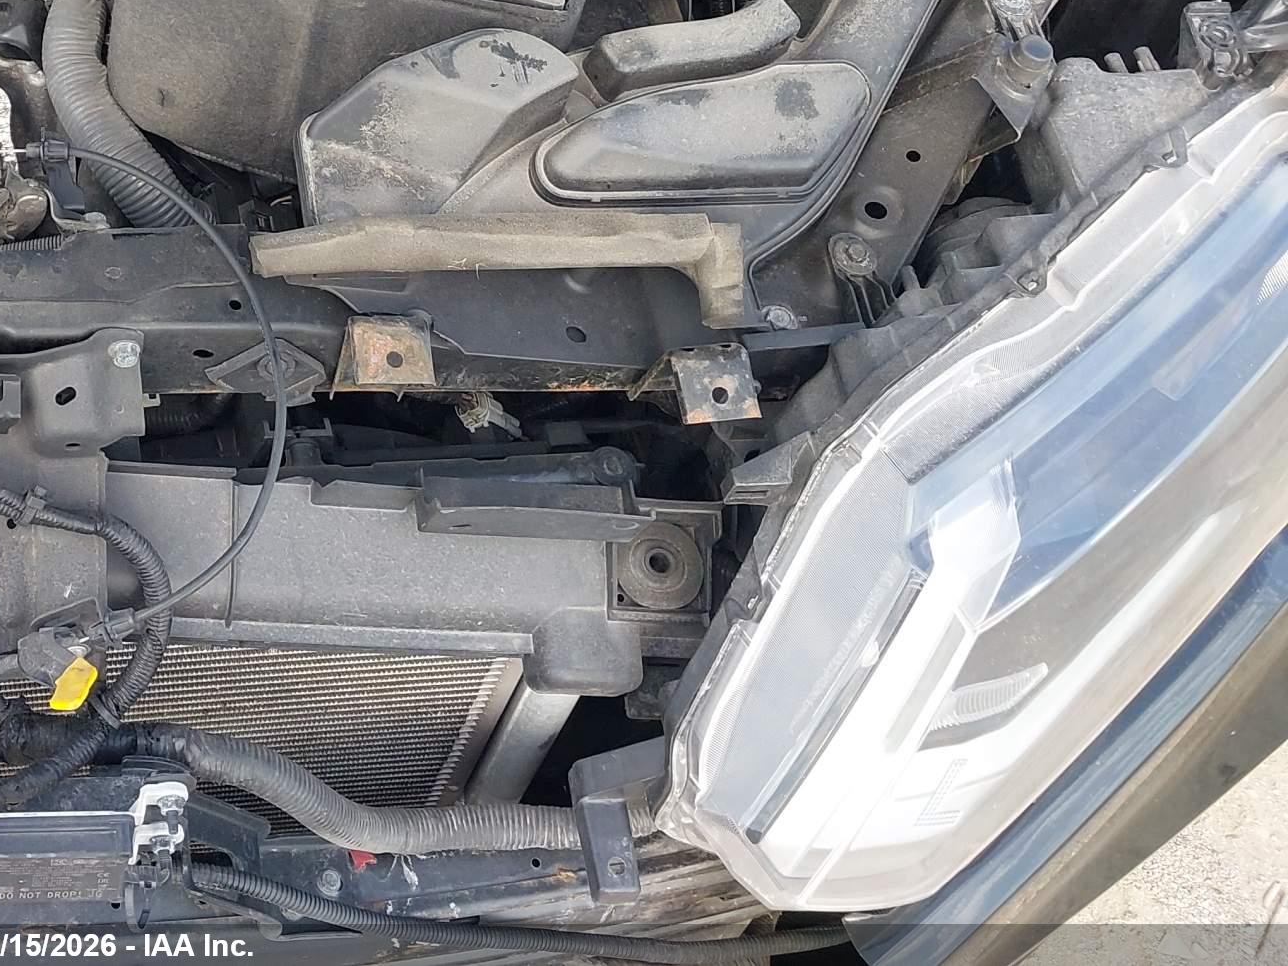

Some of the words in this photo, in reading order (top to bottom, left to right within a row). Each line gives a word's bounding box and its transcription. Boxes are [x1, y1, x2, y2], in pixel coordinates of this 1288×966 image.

[0, 891, 13, 900] DO
[19, 891, 41, 899] NOT
[47, 890, 82, 900] DROP!
